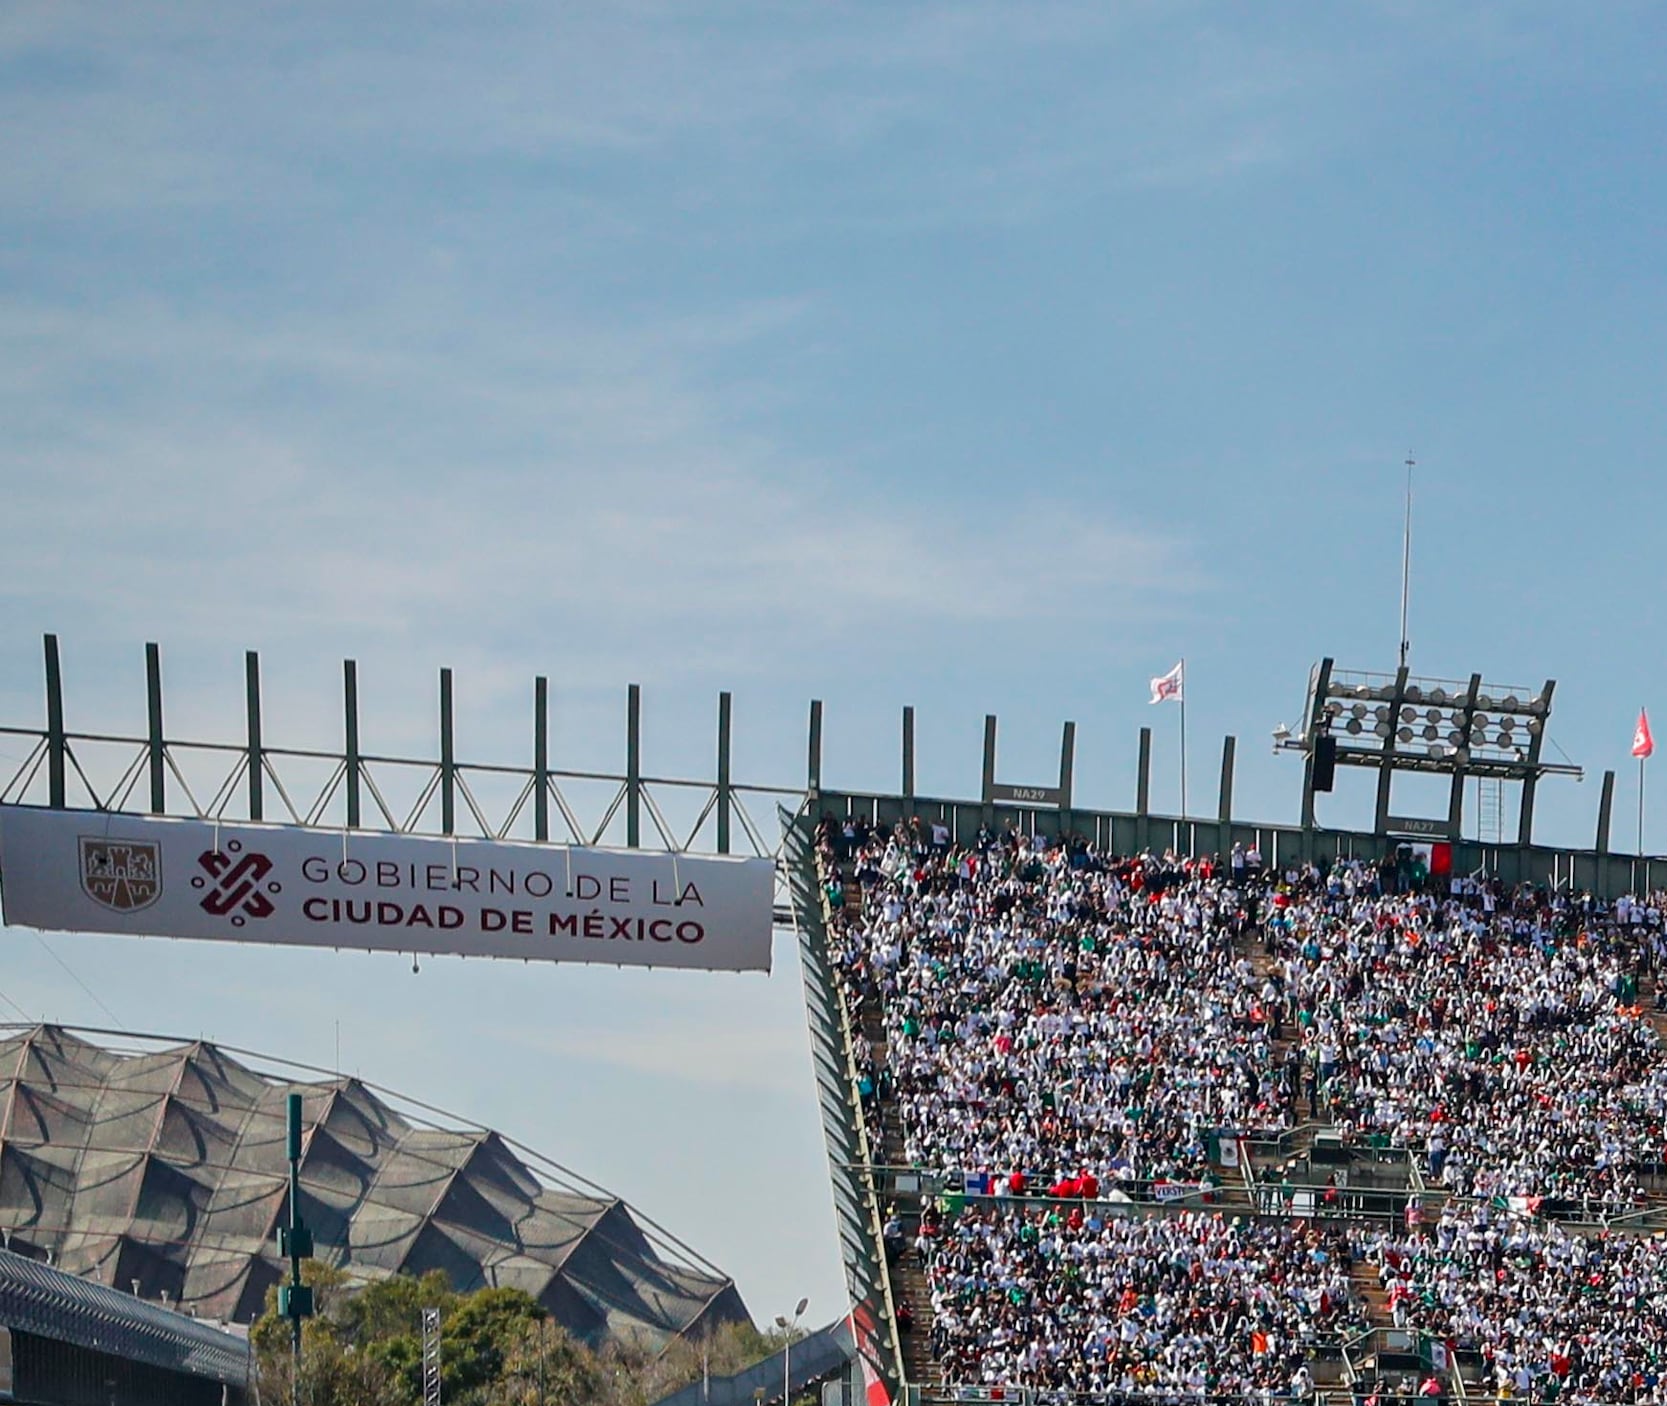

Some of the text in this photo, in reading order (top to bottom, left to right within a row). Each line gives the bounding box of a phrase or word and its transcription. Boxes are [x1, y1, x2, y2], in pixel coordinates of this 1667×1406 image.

[302, 856, 705, 906] GOBIERNO DE LA
[302, 896, 705, 944] CIUDAD DE MÉXICO
